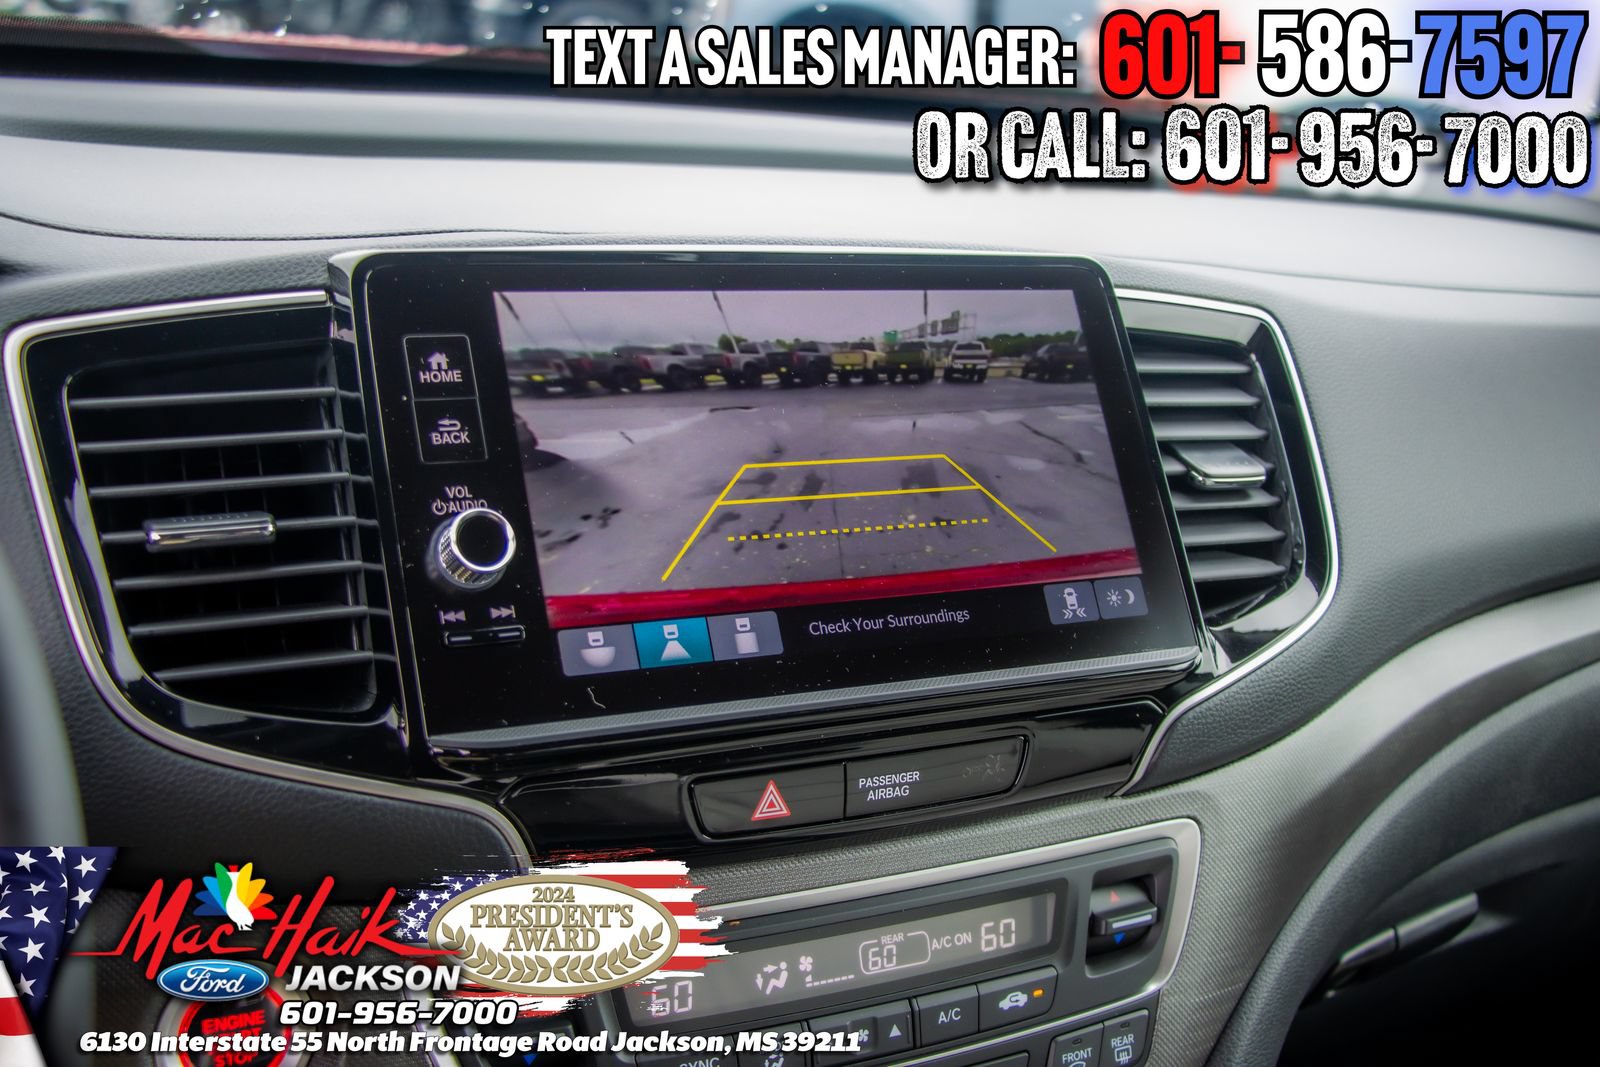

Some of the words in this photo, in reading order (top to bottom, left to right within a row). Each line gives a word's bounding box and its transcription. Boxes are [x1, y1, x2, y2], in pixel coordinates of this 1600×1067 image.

[419, 370, 463, 384] HOME
[431, 431, 471, 445] BACK
[445, 486, 473, 499] VOL
[808, 618, 851, 636] Check
[852, 617, 885, 632] Your
[887, 609, 971, 627] Surroundings
[859, 771, 920, 789] PASSENGER
[867, 785, 910, 801] AIRBAG
[881, 932, 905, 944] REAR
[932, 934, 952, 951] A/C
[954, 931, 972, 945] ON
[981, 918, 1016, 952] 60
[868, 945, 896, 971] 60
[651, 980, 693, 1018] 60
[202, 1010, 266, 1034] ENGINE
[938, 1007, 961, 1025] A/C
[1111, 1034, 1135, 1048] REAR
[1062, 1048, 1092, 1064] FRONT
